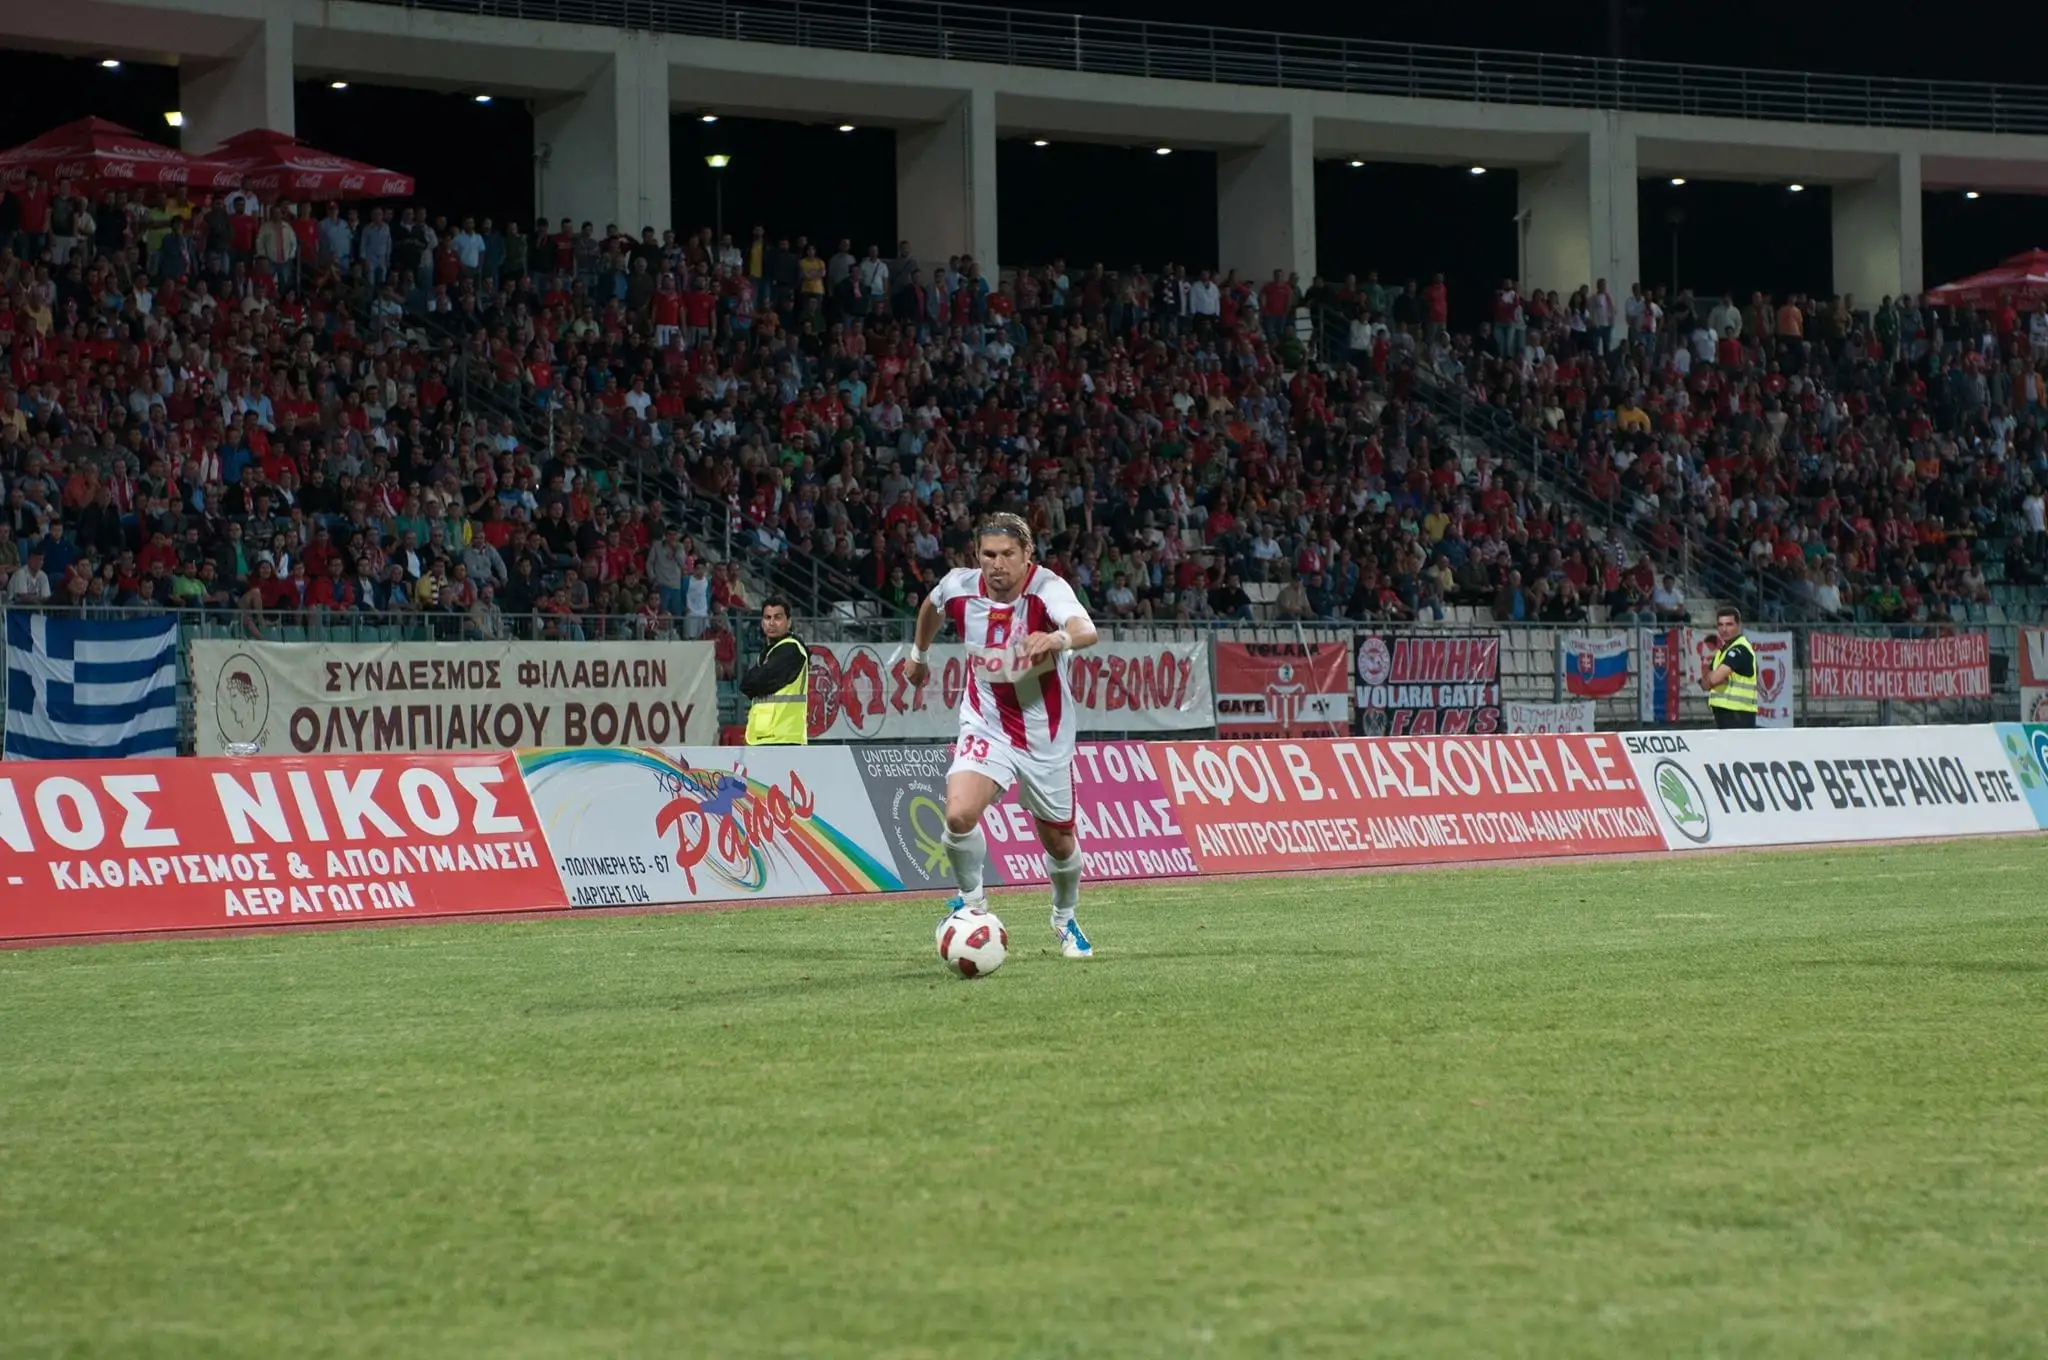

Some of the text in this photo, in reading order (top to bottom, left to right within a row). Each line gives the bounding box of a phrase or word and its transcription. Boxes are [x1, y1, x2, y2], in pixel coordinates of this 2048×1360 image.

[1245, 643, 1321, 657] VOLARA
[1389, 637, 1499, 683] ΔΙΜΗΝΙ
[1893, 639, 1924, 669] ΕΙΝΑΙ
[326, 659, 667, 692] ΣΥΝΔΕΣΜΟΣ ΦΙΛΑΘΛΩΝ
[1812, 667, 1839, 697] ΜΑΣ
[1866, 671, 1905, 698] ΕΜΕΙΣ
[1218, 699, 1265, 714] GATE
[1356, 685, 1434, 708] VOLARA
[1438, 684, 1486, 708] GATE
[1490, 684, 1500, 706] 1
[290, 702, 695, 753] ΟΛΥΜΠΙΑΚΟΥ ΒΟΛΟΥ
[1390, 707, 1500, 735] FANS
[1511, 704, 1584, 723] OLYMPIAKOS
[862, 748, 947, 763] UNITED COLORS
[1626, 735, 1690, 754] SKODA
[868, 764, 882, 777] OF
[1165, 737, 1635, 806] ΑΦΟΙ Β. ΠΑΣΧΟΥΔΗ Α.Ε.
[1704, 756, 2020, 814] ΜΟΤΟΡ ΒΕΤΕΡΑΝΟΙ ΕΠΕ
[212, 766, 522, 844] ΝΙΚΟΣ
[983, 798, 1182, 842] ΘΕΑΛΙΑΣ
[655, 770, 815, 896] Panos
[1195, 806, 1657, 858] ΑΝΤΙΠΡΟΣΩΠΕΙΕΣ-ΔΙΑΝΟΜΕΣ ΠΟΤΩΝ-ΑΝΑΨΥΚΤΙΚΩΝ
[49, 852, 275, 890] ΚΑΘΑΡΙΣΜΟΣ
[287, 851, 313, 879] &
[327, 841, 538, 878] ΑΠΟΛΥΜΑΝΣΗ
[630, 855, 645, 874] 65
[655, 854, 671, 874] 67
[1136, 847, 1198, 875] ΒΟΛΟΣ
[225, 880, 415, 917] ΑΕΡΑΓΩΓΩΝ
[625, 884, 649, 903] 104
